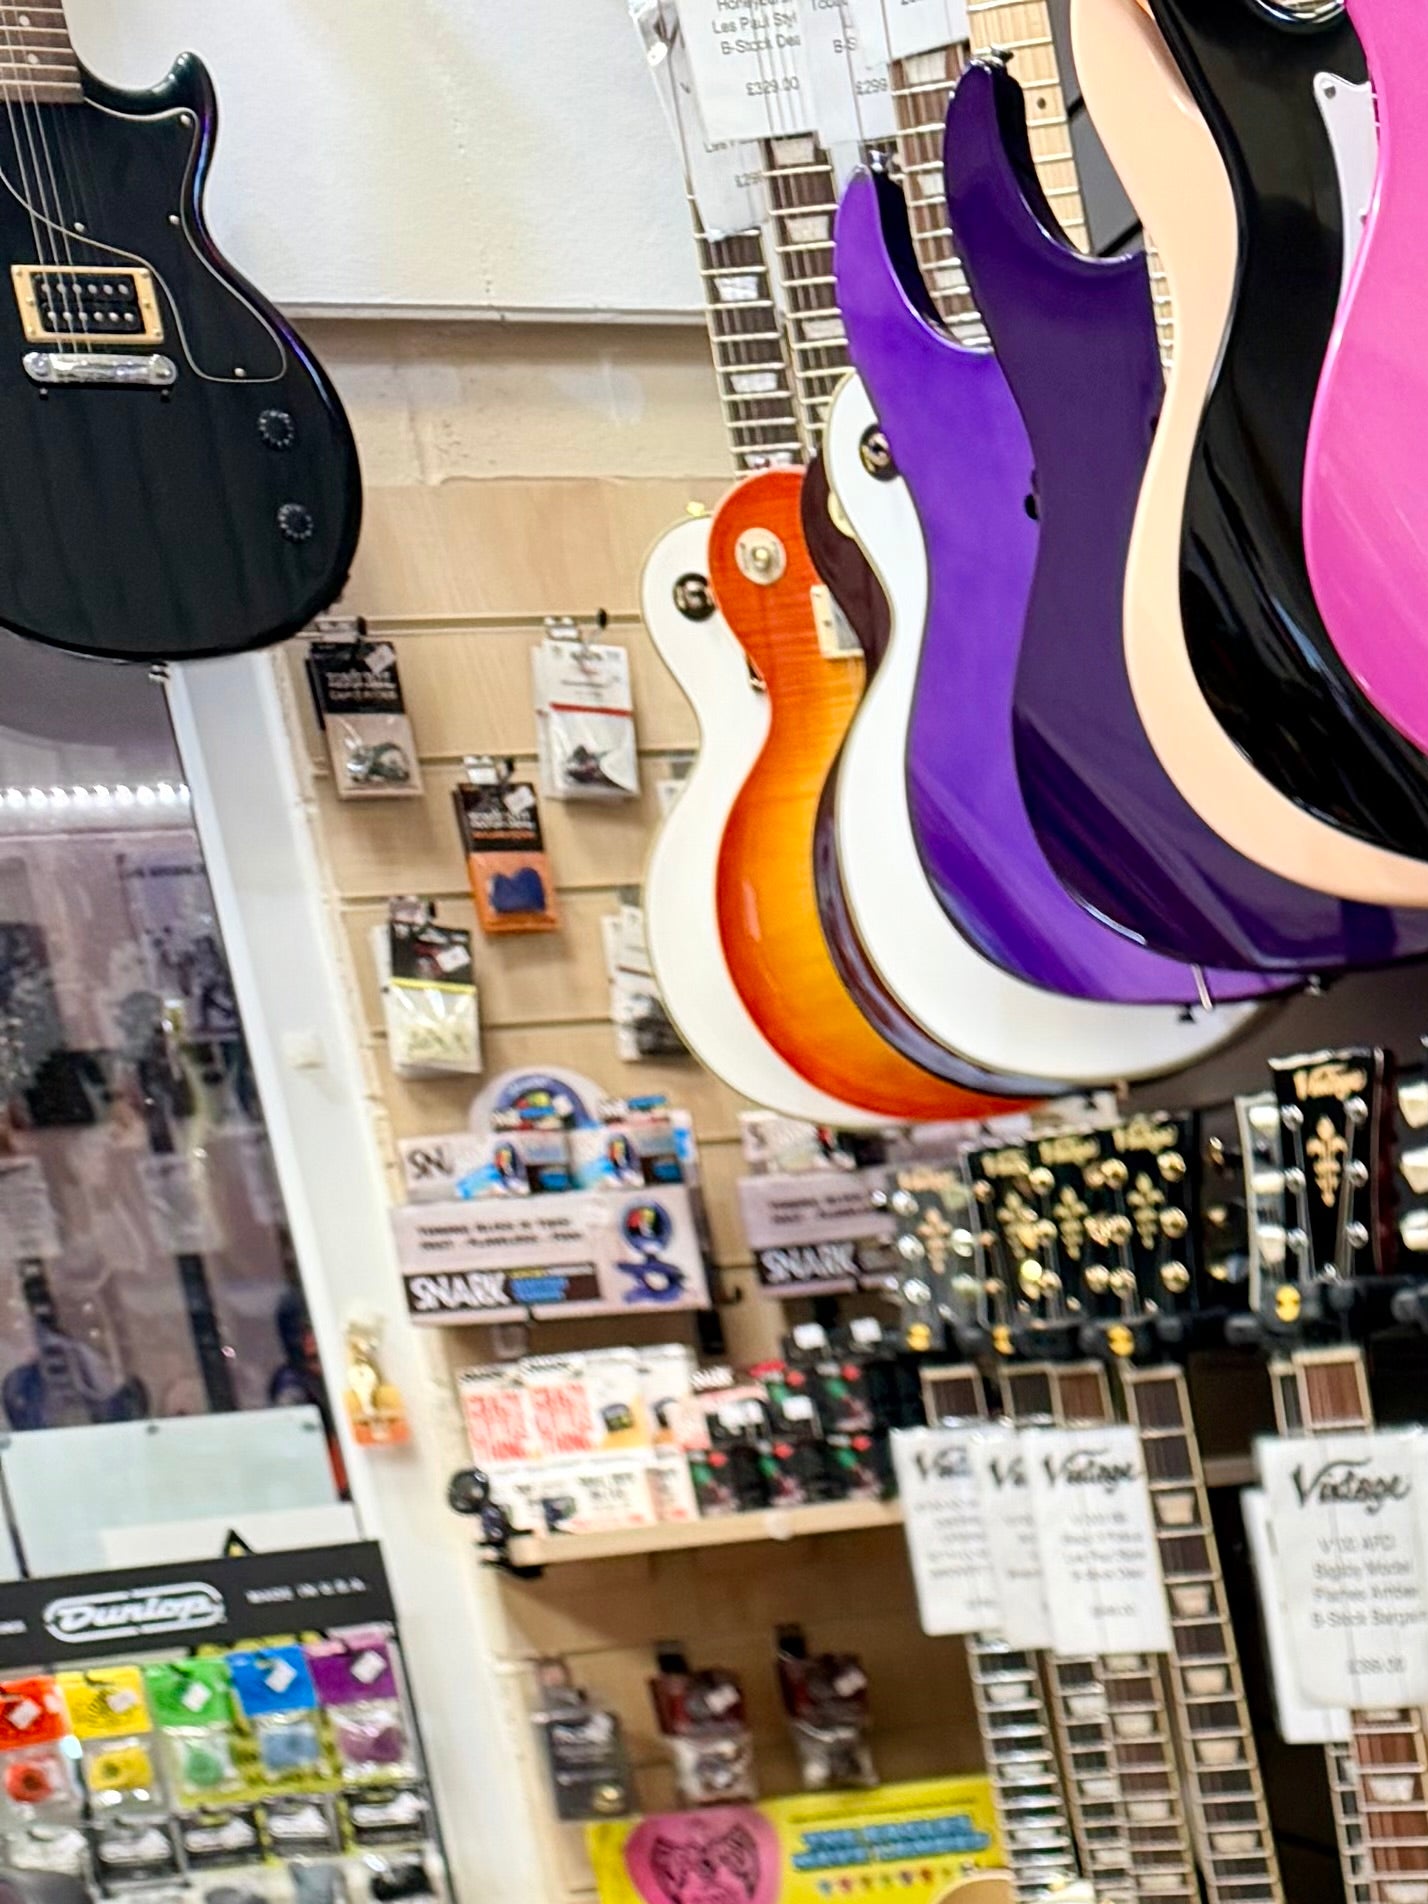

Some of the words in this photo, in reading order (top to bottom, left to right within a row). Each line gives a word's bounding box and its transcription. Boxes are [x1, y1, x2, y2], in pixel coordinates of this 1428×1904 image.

[776, 34, 801, 49] Dea
[1290, 1457, 1412, 1515] Vintage
[57, 1597, 214, 1632] Dunlop
